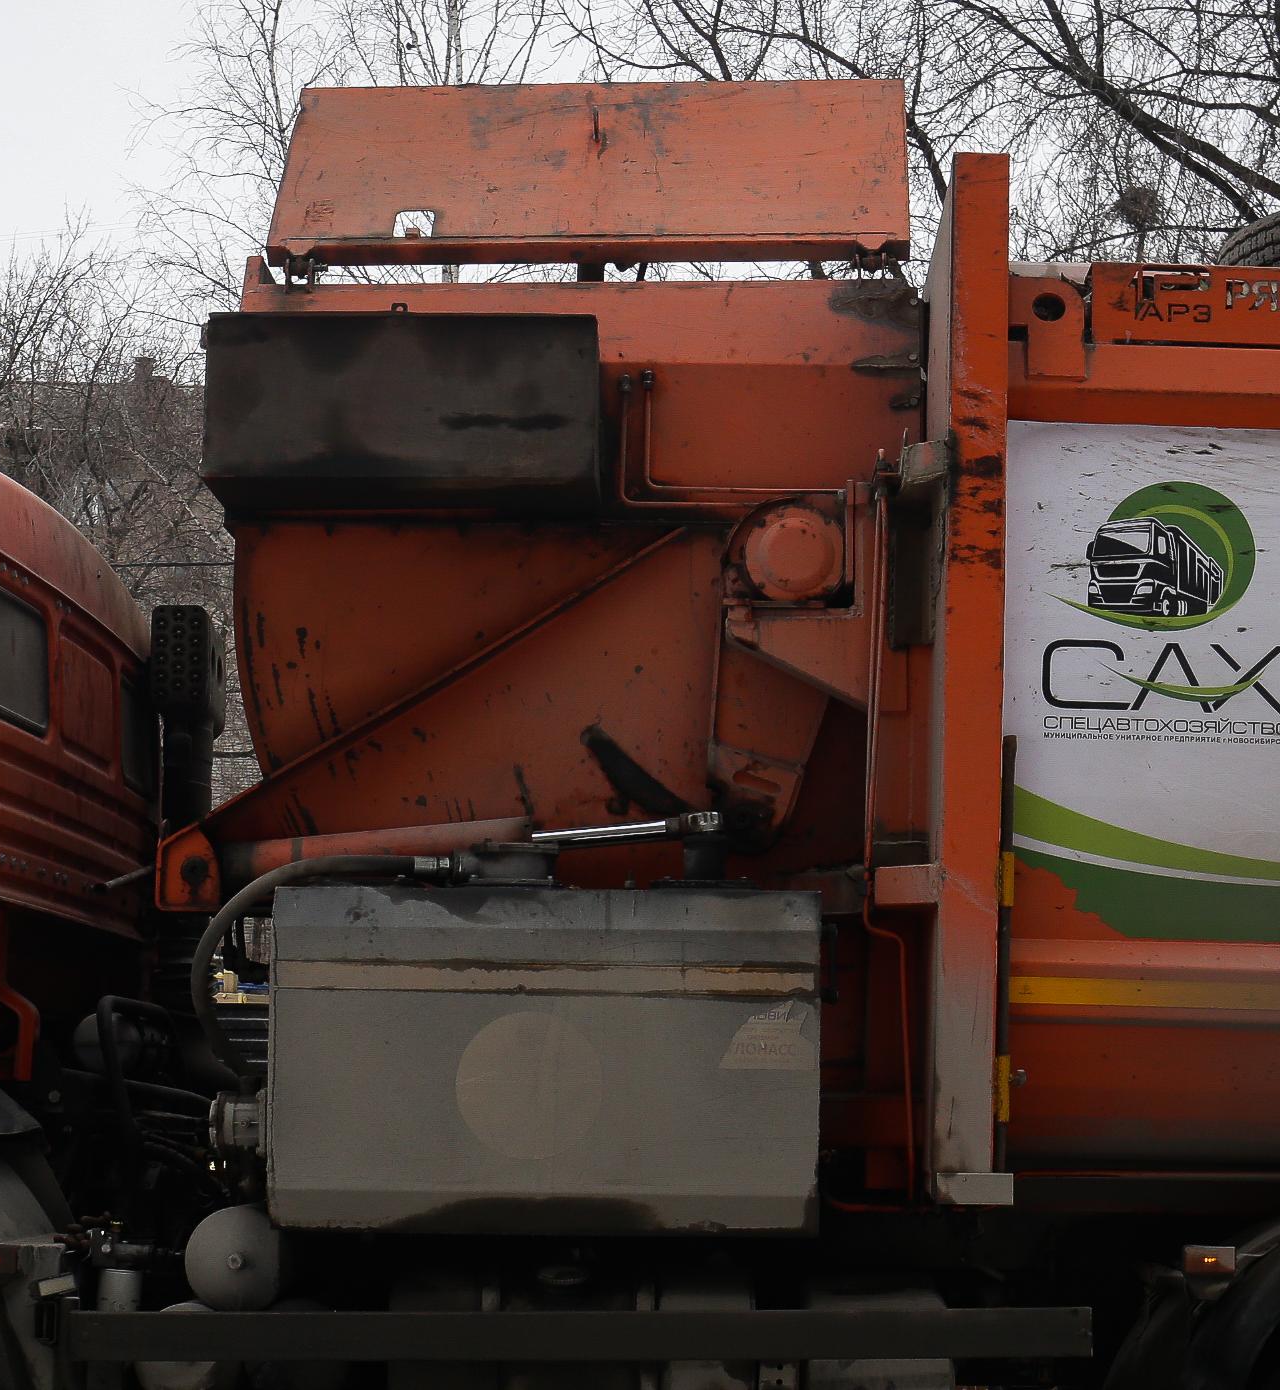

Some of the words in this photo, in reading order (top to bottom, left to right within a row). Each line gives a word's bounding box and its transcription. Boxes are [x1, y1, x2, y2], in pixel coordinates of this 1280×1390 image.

[1136, 303, 1212, 323] АРЗ
[1043, 732, 1114, 741] МУНИЦИПАЛЬНОЕ
[1115, 733, 1162, 742] УНИТАРНОЕ
[1163, 735, 1221, 744] ПРЕДПРИЯТИЕ
